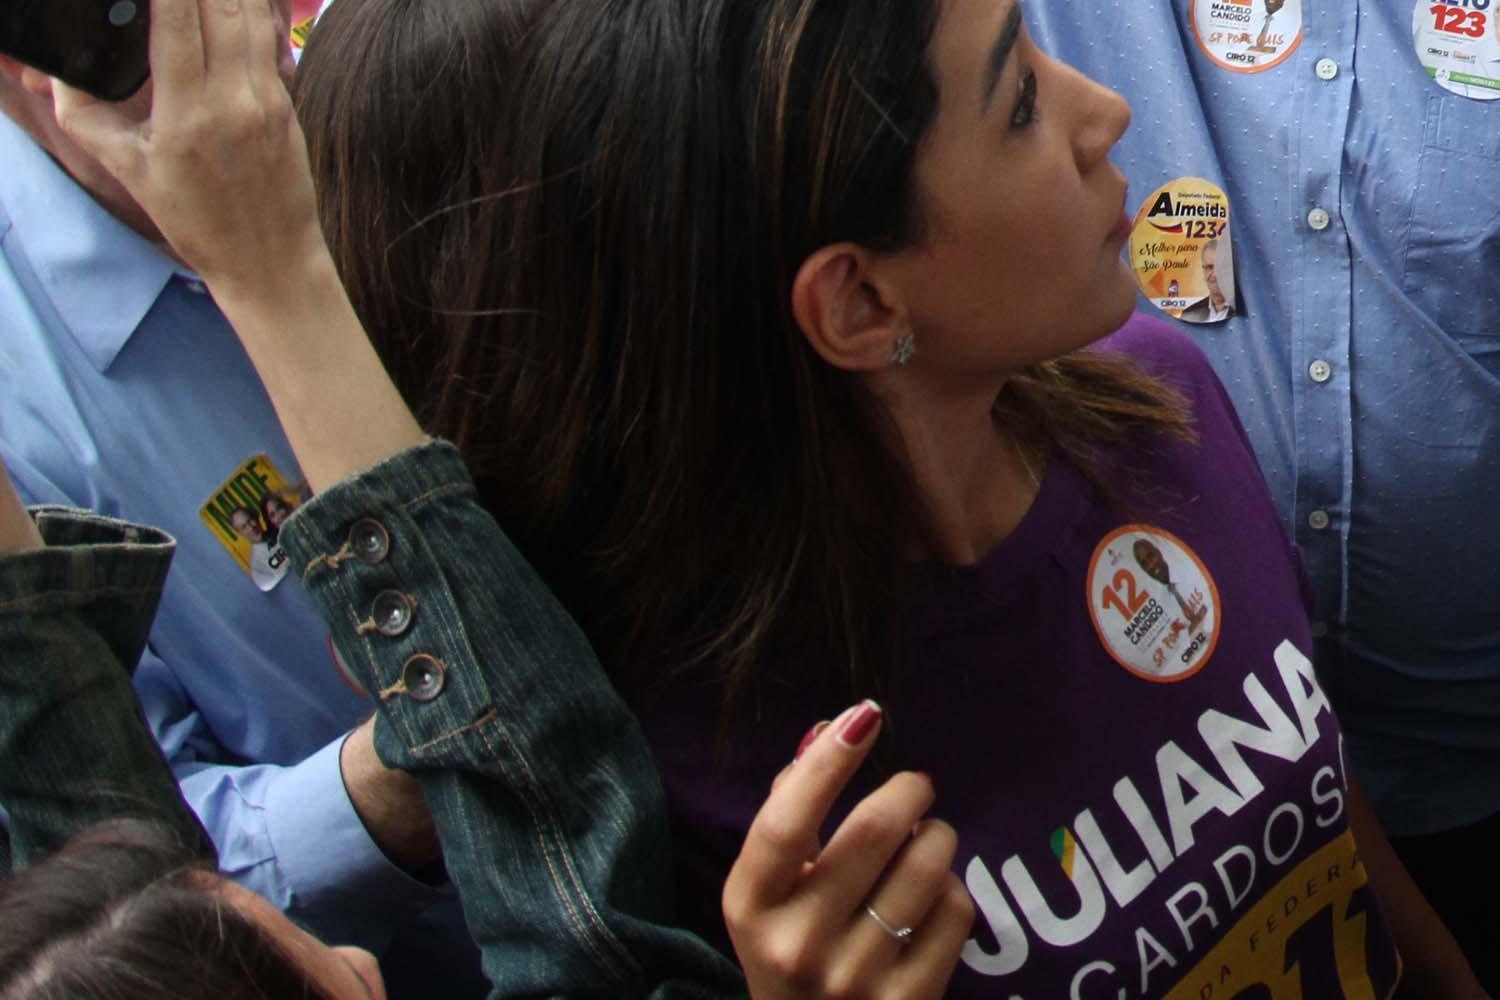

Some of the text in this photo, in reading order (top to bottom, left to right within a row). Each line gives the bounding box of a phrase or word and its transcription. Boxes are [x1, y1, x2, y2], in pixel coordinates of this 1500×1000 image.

[1210, 10, 1251, 23] CANDIDO
[1211, 3, 1252, 15] MARCELO
[1429, 4, 1487, 38] 123
[1225, 51, 1246, 62] CIRO
[1147, 192, 1226, 218] Almeida
[1139, 240, 1200, 257] Melhor para
[1143, 258, 1189, 272] São Paulo
[206, 458, 268, 541] MUDE
[1102, 568, 1150, 622] 12
[1123, 598, 1157, 638] MARCELO
[1130, 605, 1164, 645] CANDIDO
[1181, 641, 1199, 663] CIRO
[960, 639, 1332, 976] JULIANA
[1070, 732, 1349, 1000] CARDOS
